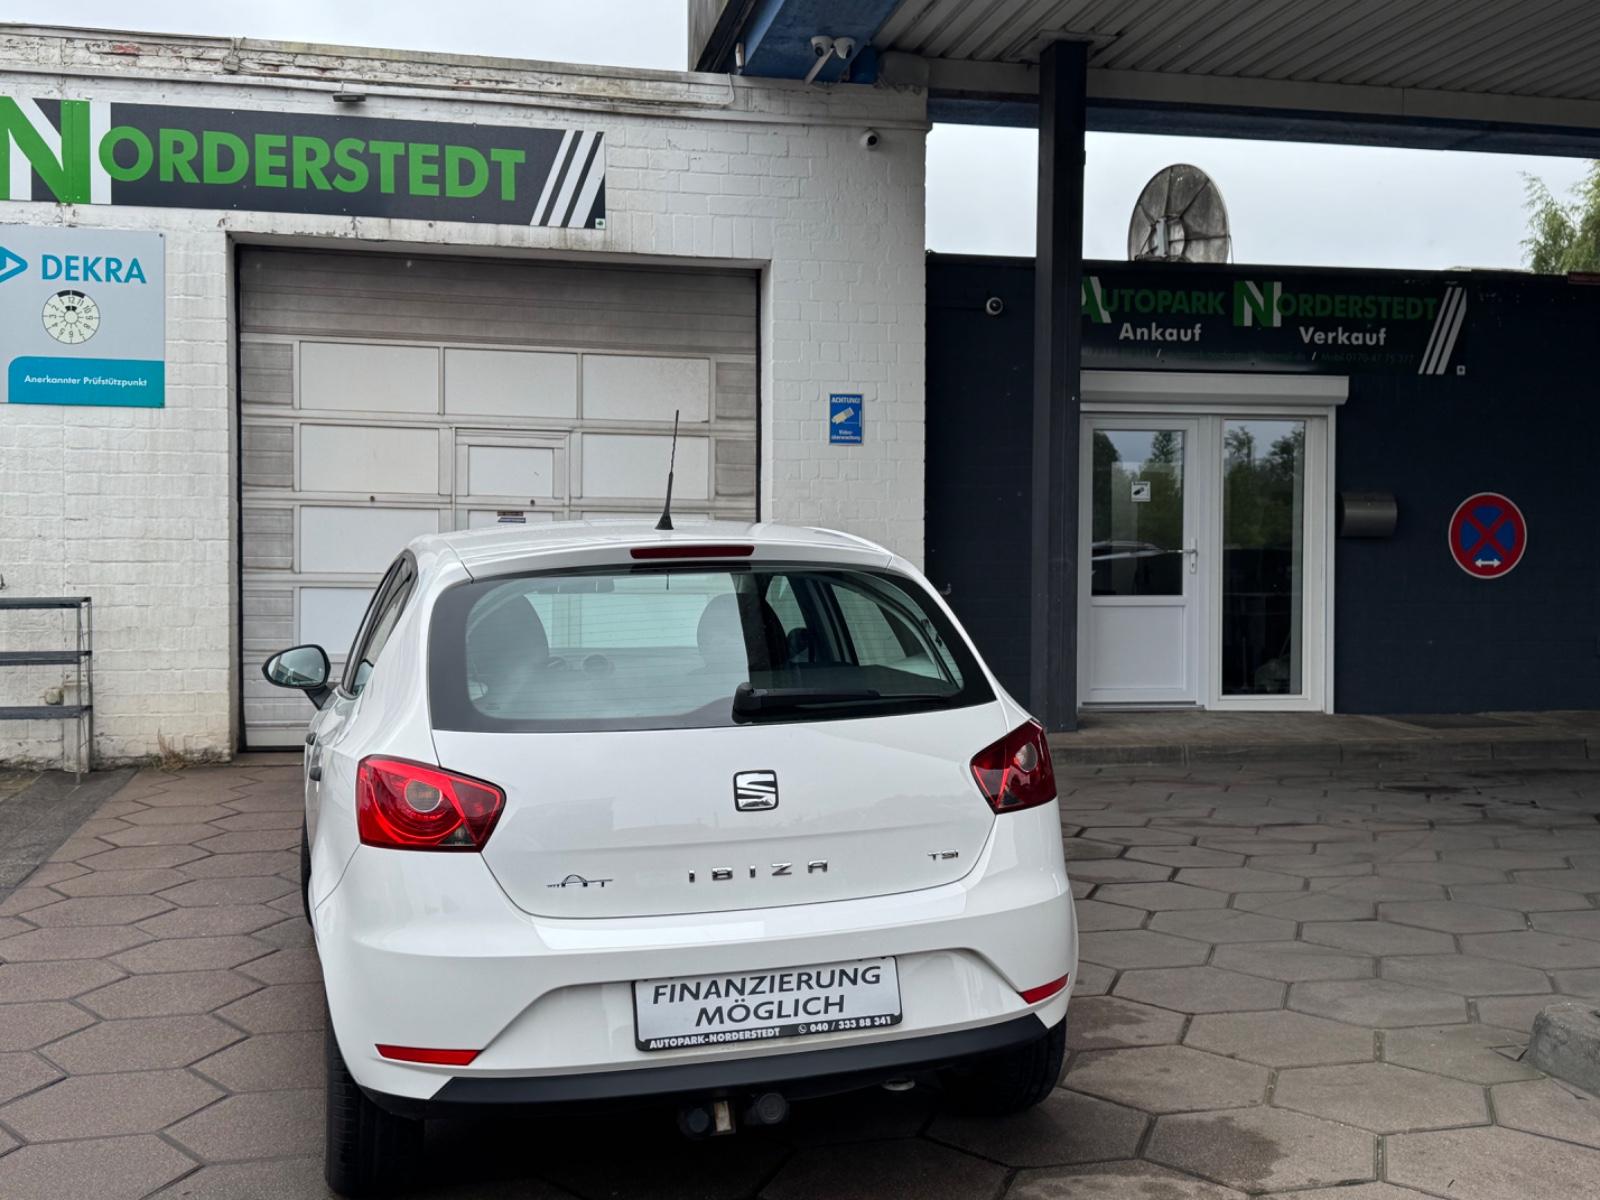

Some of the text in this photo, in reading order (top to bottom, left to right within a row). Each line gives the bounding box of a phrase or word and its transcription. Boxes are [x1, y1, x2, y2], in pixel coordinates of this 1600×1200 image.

[0, 96, 526, 204] NORDERSTEDT
[41, 254, 147, 284] DEKRA
[1080, 276, 1438, 327] AUTOPARK NORDERSTEDT
[1118, 322, 1202, 342] Ankauf
[1299, 326, 1387, 346] Verkauf
[24, 375, 147, 388] Anerkannter Prüfstützpunkt
[928, 849, 959, 861] TSI
[688, 858, 829, 883] IBIZA
[652, 965, 881, 1005] FINANZIERUNG
[695, 994, 845, 1027] MÖGLICH
[650, 1027, 780, 1049] AUTOPARK-NORDERSTEDT
[809, 1022, 829, 1033] 040
[838, 1019, 857, 1030] 333
[859, 1018, 872, 1028] 88
[874, 1016, 892, 1026] 341
